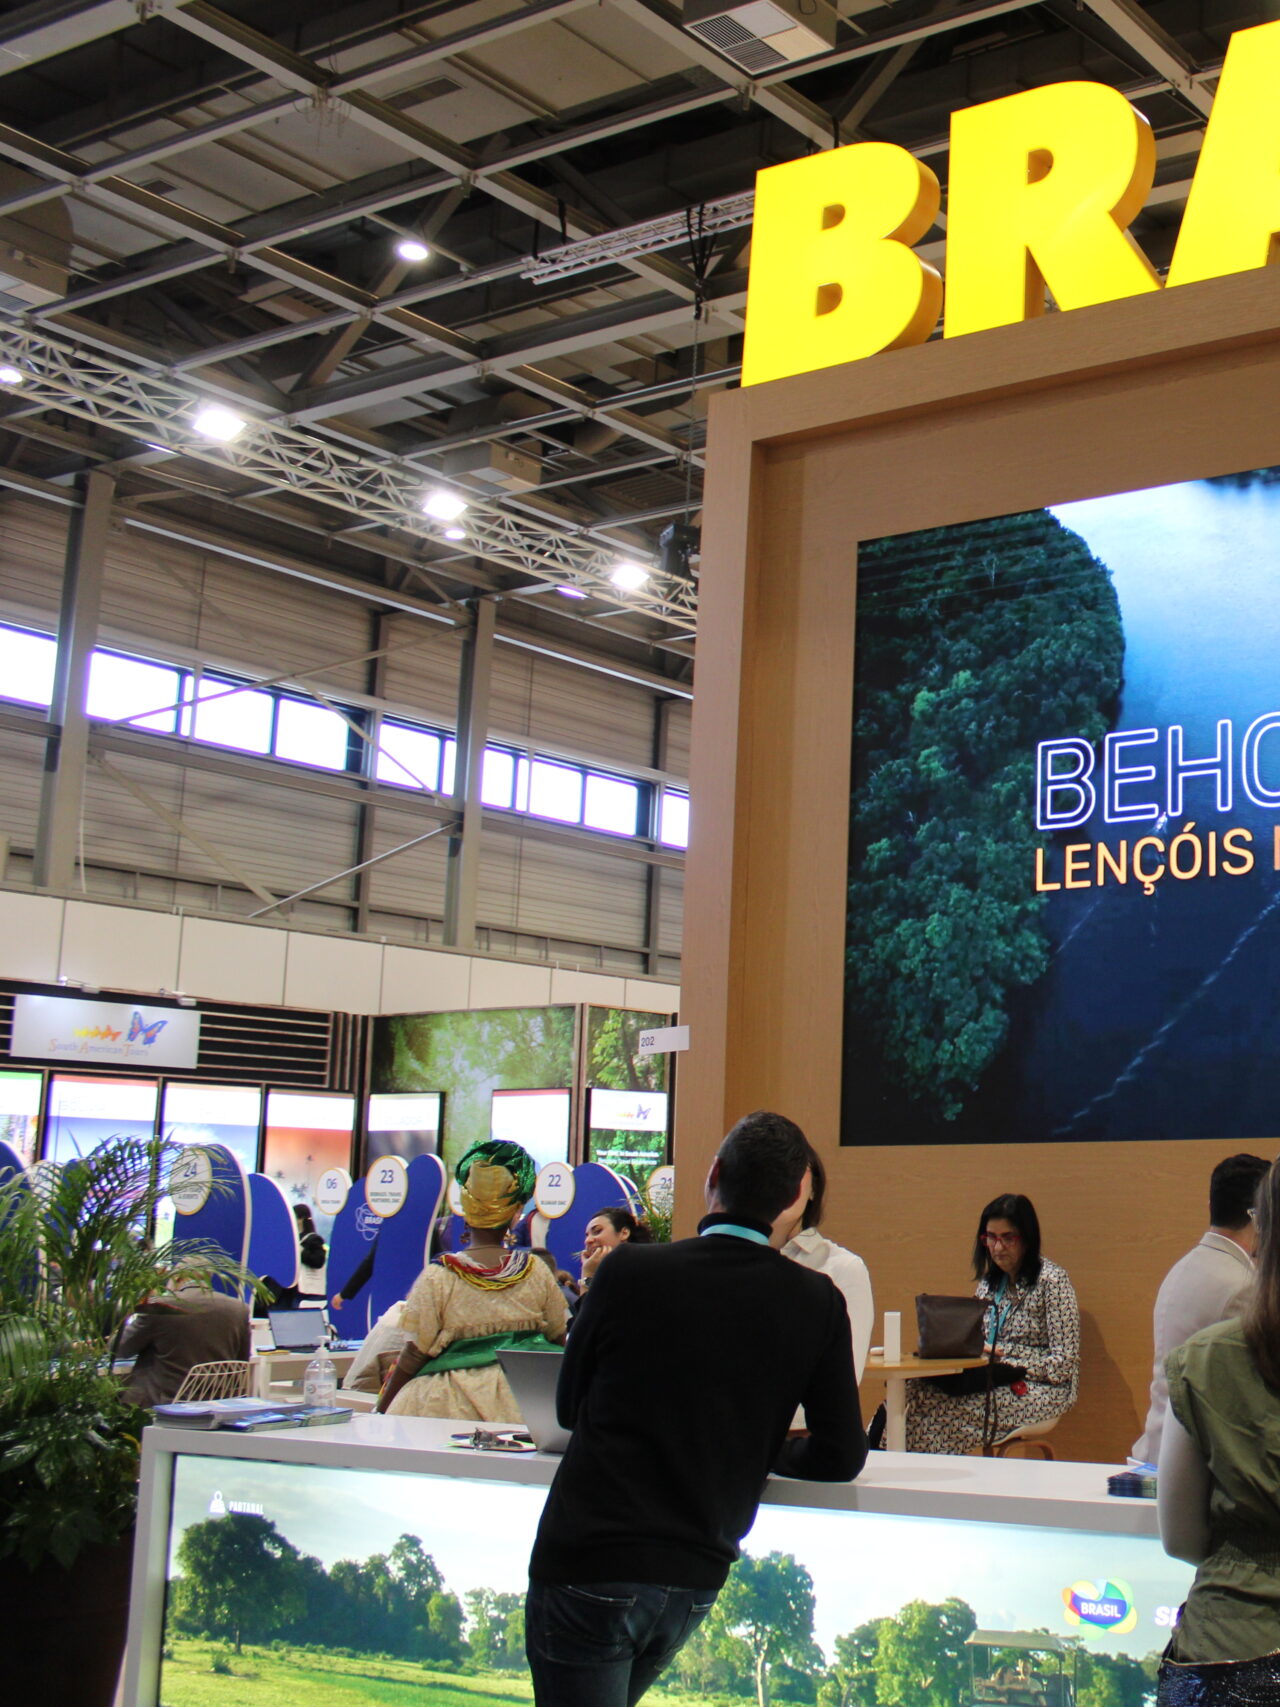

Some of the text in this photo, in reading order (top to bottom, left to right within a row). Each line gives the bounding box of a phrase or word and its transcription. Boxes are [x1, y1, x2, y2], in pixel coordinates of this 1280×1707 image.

[1035, 822, 1255, 895] LENÇÓIS
[48, 1038, 148, 1056] South American Tours
[641, 1036, 655, 1047] 202
[184, 1162, 198, 1178] 24
[380, 1169, 394, 1184] 23
[326, 1178, 337, 1189] 06
[548, 1174, 561, 1187] 22
[660, 1177, 672, 1190] 21
[229, 1500, 264, 1514] PANTANAL
[1080, 1602, 1121, 1618] BRASIL
